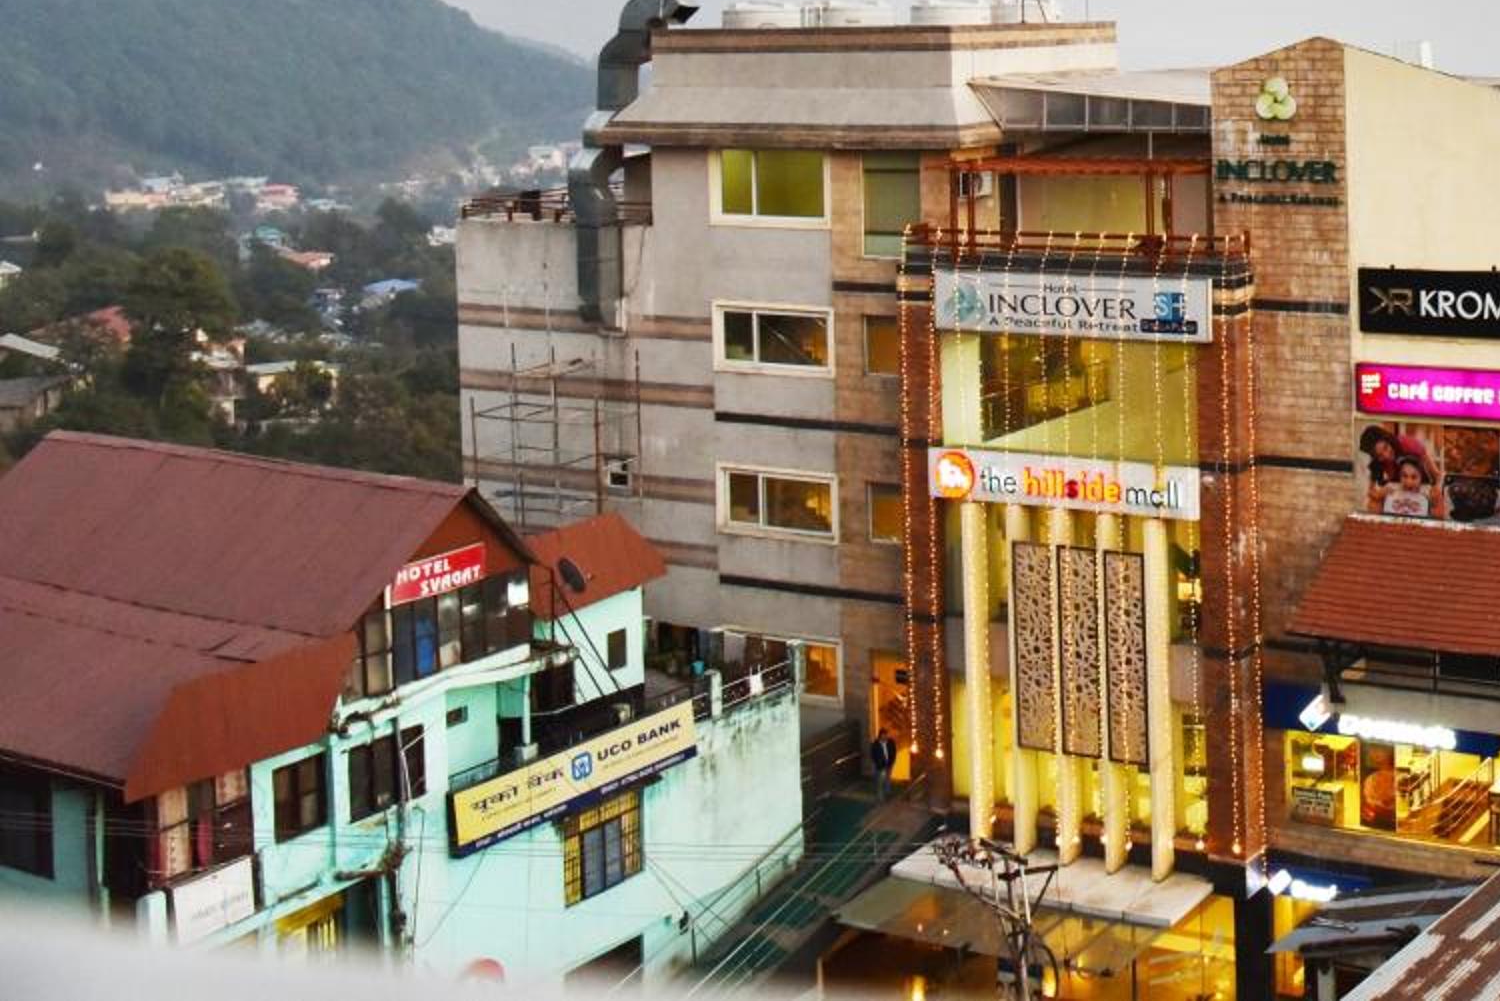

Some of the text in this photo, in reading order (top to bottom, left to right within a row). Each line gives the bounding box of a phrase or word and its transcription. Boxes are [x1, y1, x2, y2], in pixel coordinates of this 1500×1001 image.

[1215, 159, 1337, 183] INCLOVER
[1043, 282, 1078, 294] Hotel
[987, 292, 1137, 320] INCLOVER
[988, 316, 999, 326] A
[980, 466, 1180, 510] the hillside mall
[396, 558, 451, 585] HOTEL
[597, 740, 633, 762] UCO
[637, 718, 682, 745] BANK
